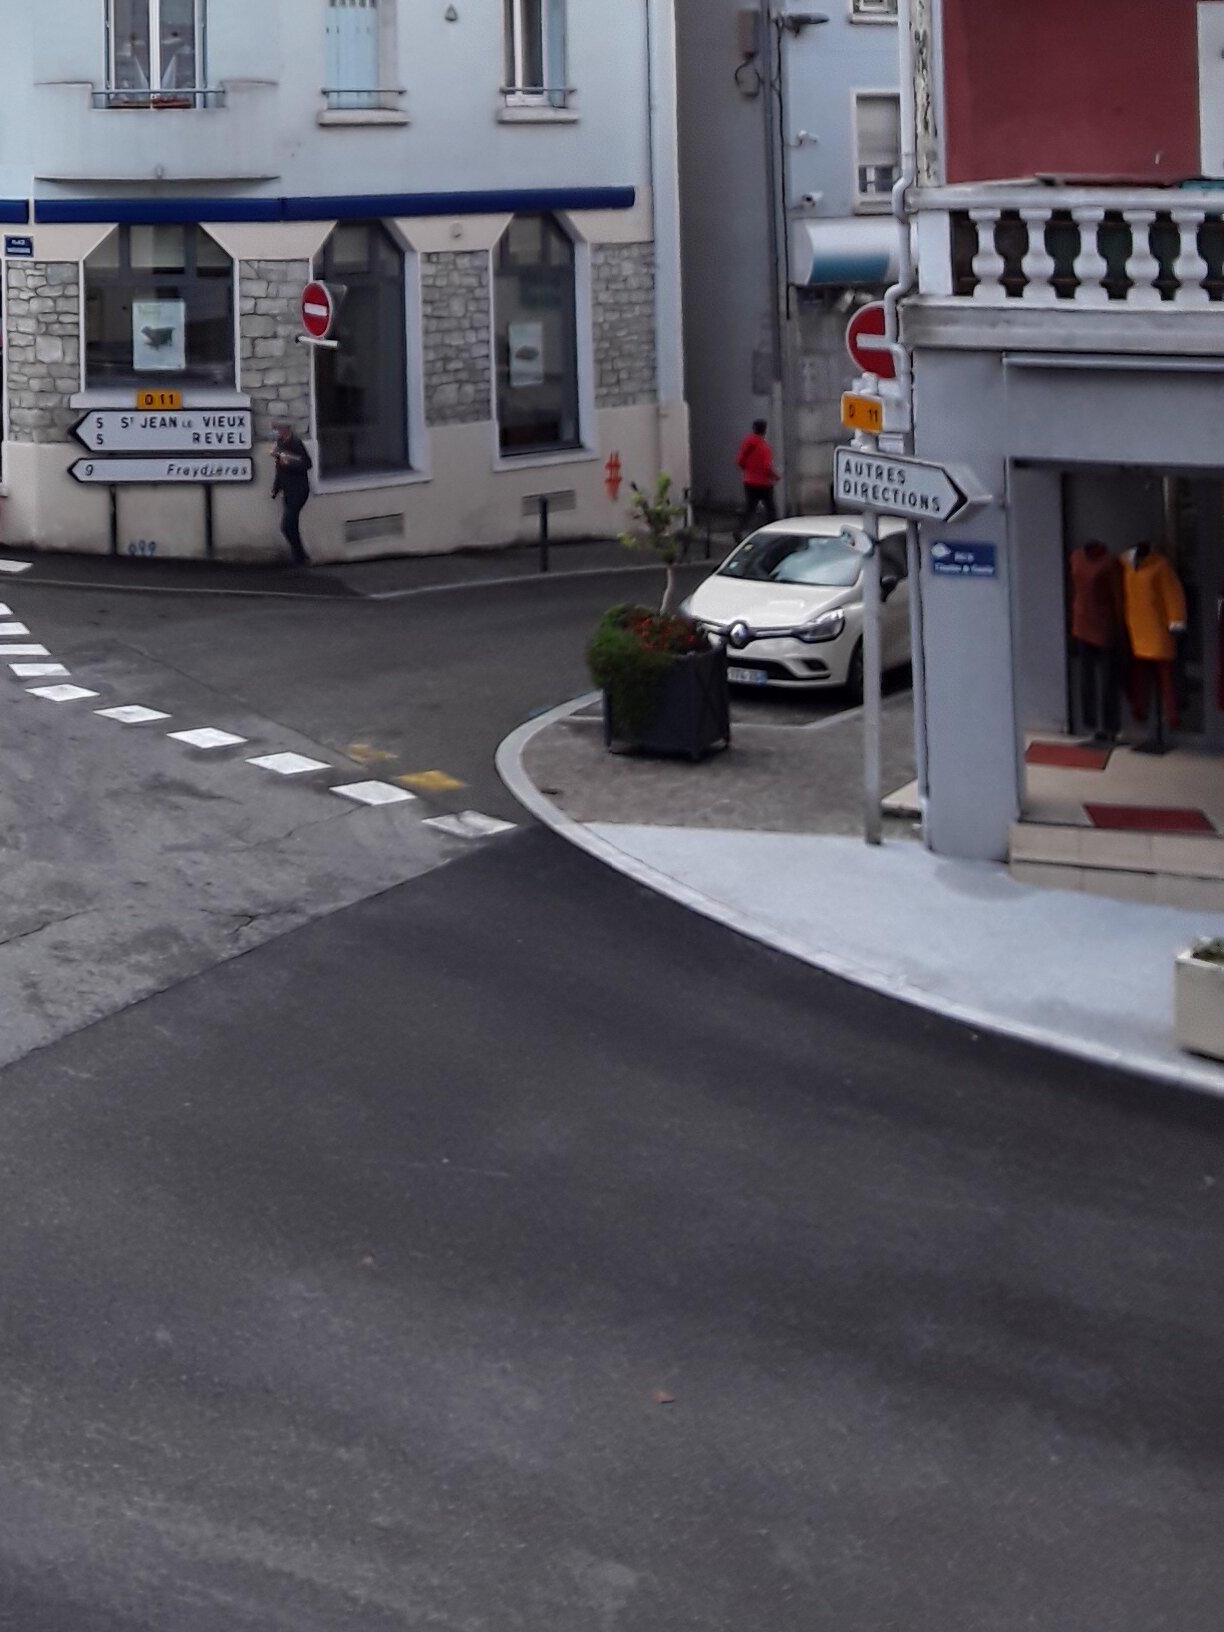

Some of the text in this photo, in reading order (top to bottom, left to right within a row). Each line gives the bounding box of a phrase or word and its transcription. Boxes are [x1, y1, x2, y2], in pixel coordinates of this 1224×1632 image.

[140, 416, 177, 429] JEAN
[202, 415, 246, 428] VIEUX
[192, 432, 246, 444] REVEL
[85, 464, 94, 476] 9
[844, 458, 907, 485] AUTRES
[843, 480, 941, 512] DIRECTIONS
